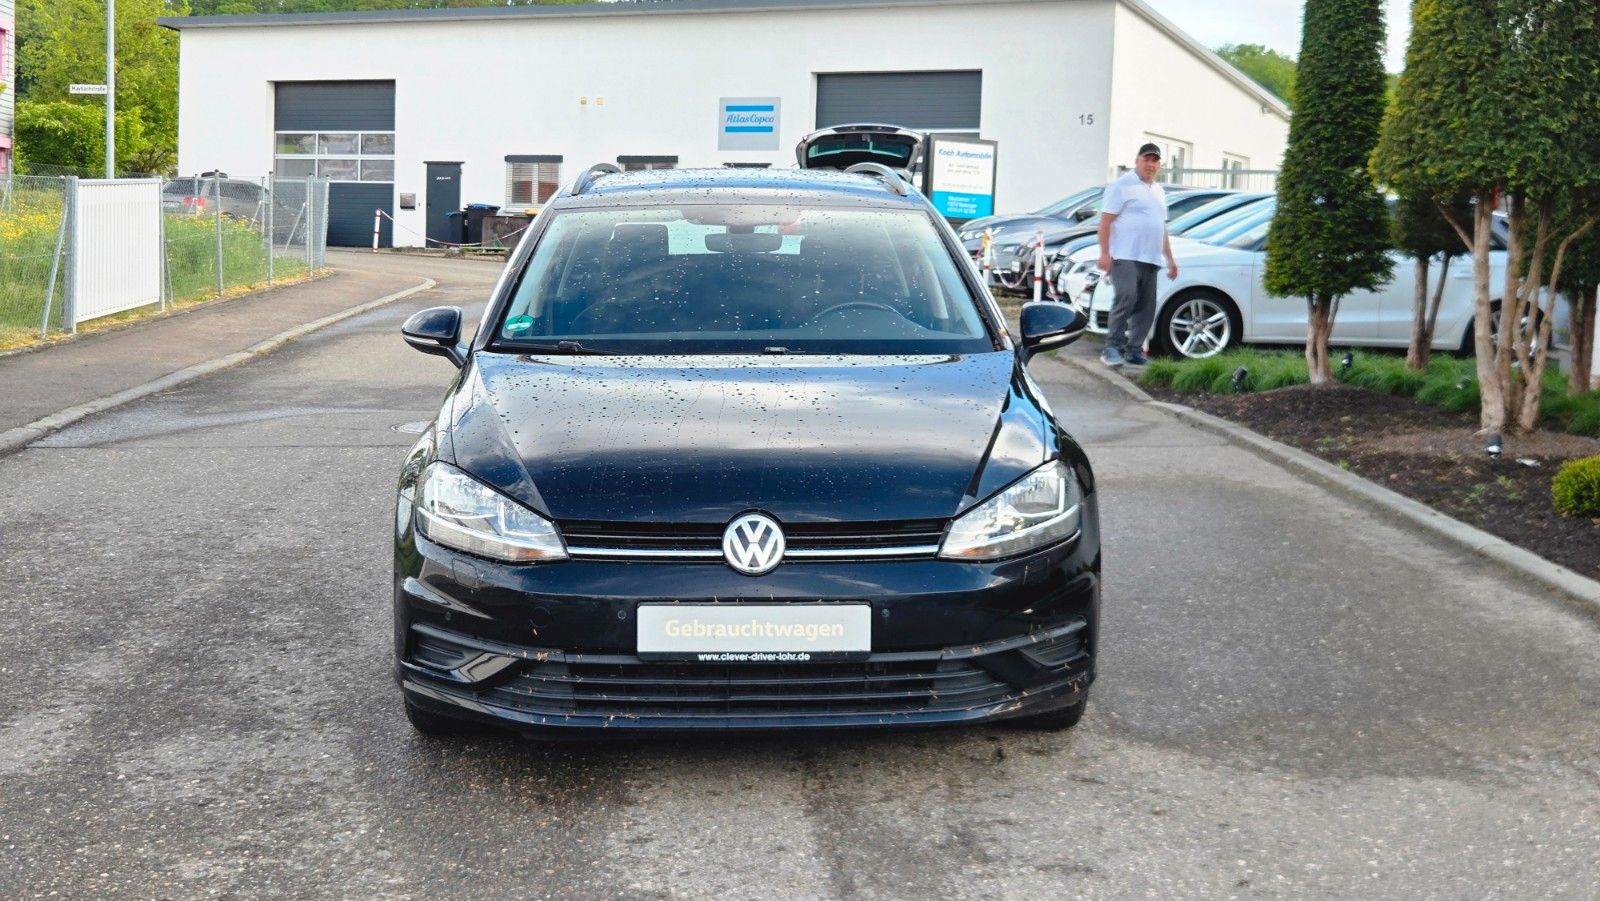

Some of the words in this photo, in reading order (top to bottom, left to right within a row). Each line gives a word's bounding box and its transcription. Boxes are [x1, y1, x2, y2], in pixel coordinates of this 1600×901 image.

[726, 113, 750, 123] Atlas
[750, 113, 774, 125] Copco
[1079, 113, 1094, 126] 15
[938, 148, 954, 156] Koch
[956, 150, 992, 159] Automobile
[726, 517, 782, 571] VW
[665, 619, 844, 642] Gebrauchtwagen
[697, 652, 811, 661] www.clever-driver-lohr.de
